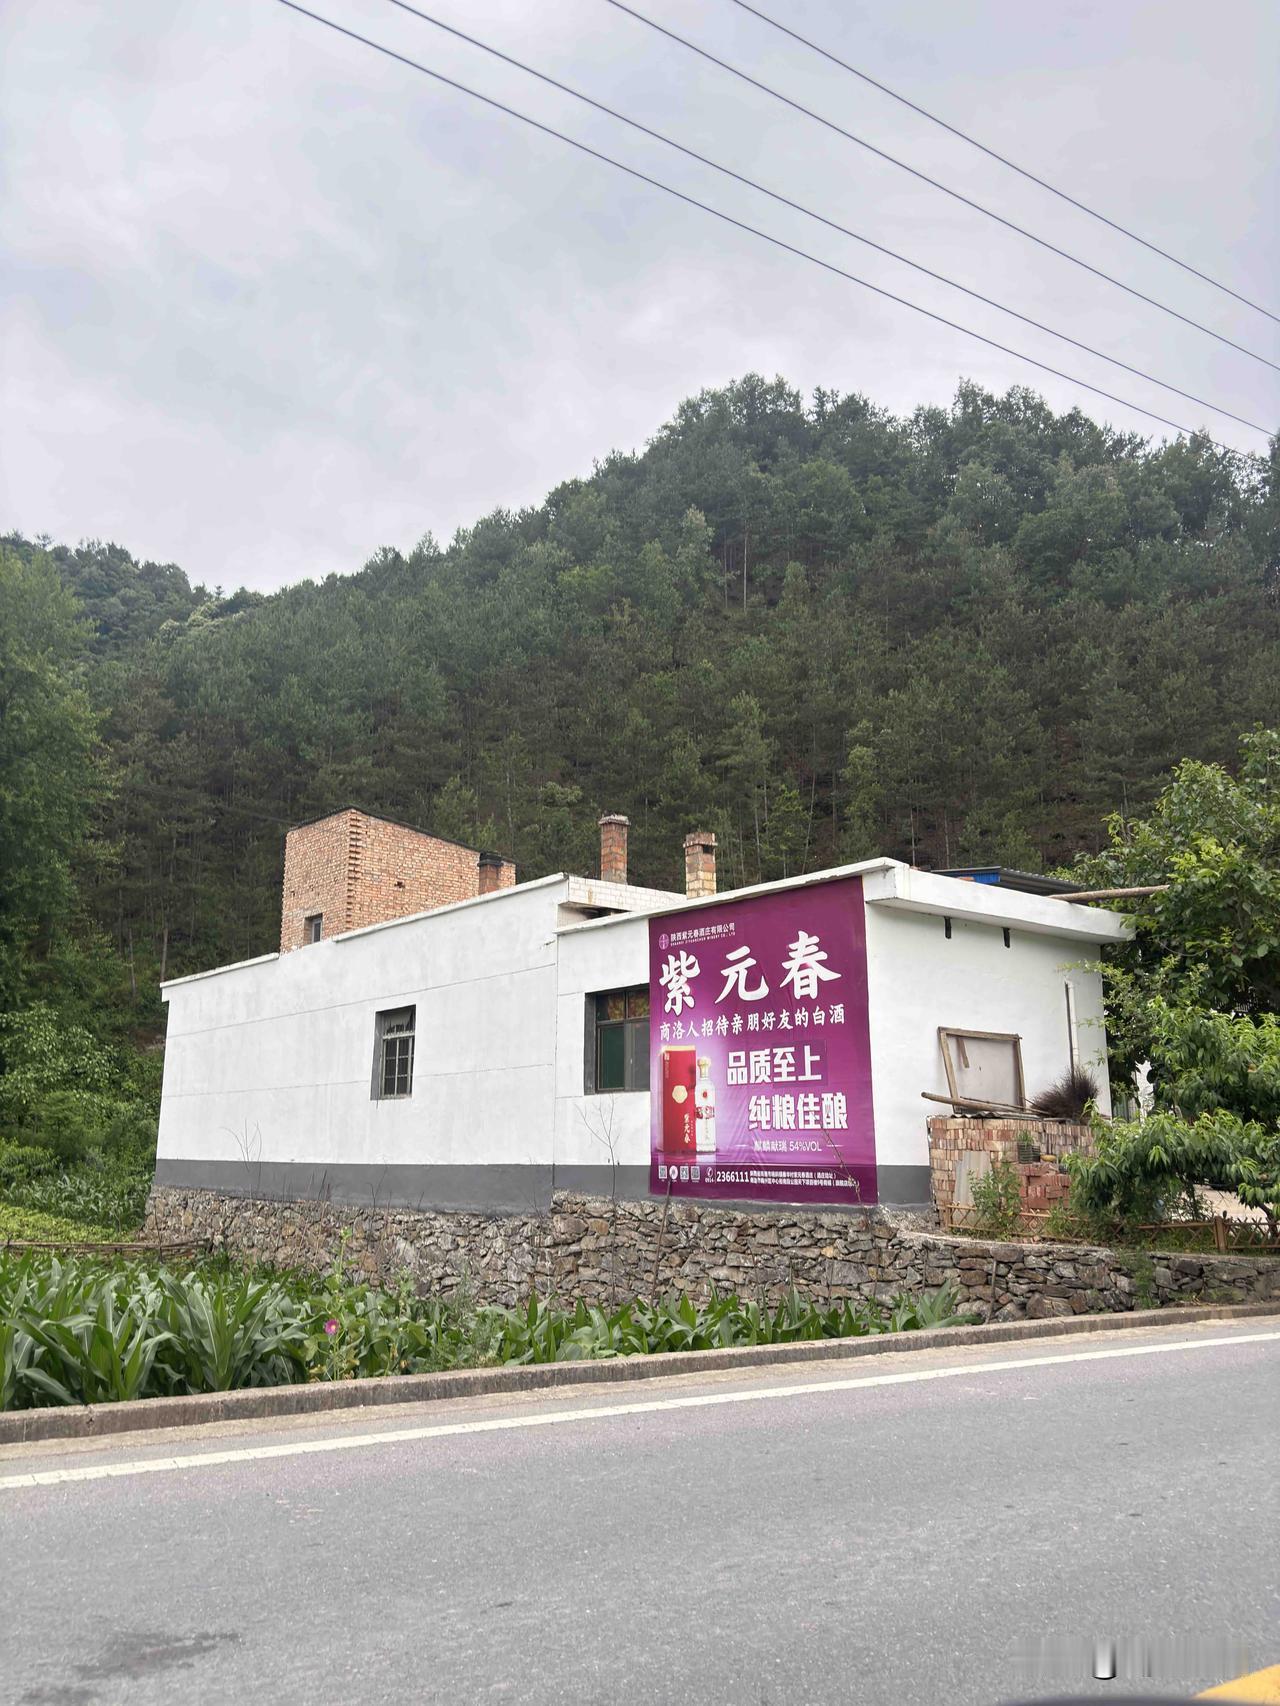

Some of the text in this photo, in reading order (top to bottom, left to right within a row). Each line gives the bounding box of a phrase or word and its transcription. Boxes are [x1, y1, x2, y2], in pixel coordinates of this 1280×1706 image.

[670, 923, 735, 942] 陕西紫元春酒庄有限公司
[659, 930, 841, 1016] 紫元春
[660, 1003, 845, 1041] 商洛人招待亲朋好友的白酒
[727, 1045, 822, 1085] 品质至上
[749, 1092, 848, 1130] 纯粮佳酿
[789, 1140, 822, 1152] 54%VOL
[716, 1171, 749, 1183] 2366111
